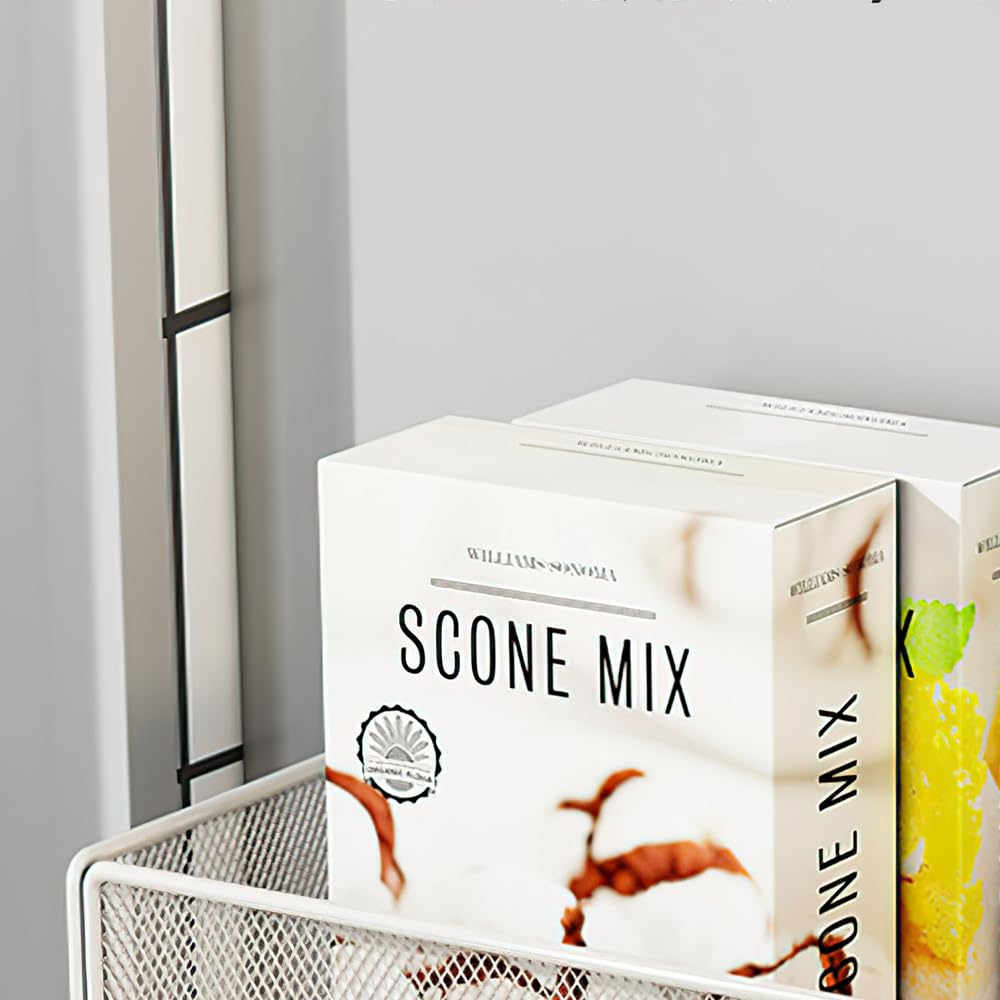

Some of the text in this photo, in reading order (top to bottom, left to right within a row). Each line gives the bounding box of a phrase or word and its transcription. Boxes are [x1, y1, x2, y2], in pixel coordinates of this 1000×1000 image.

[399, 603, 691, 718] SCONE MIX
[818, 693, 858, 993] CONE MIX
